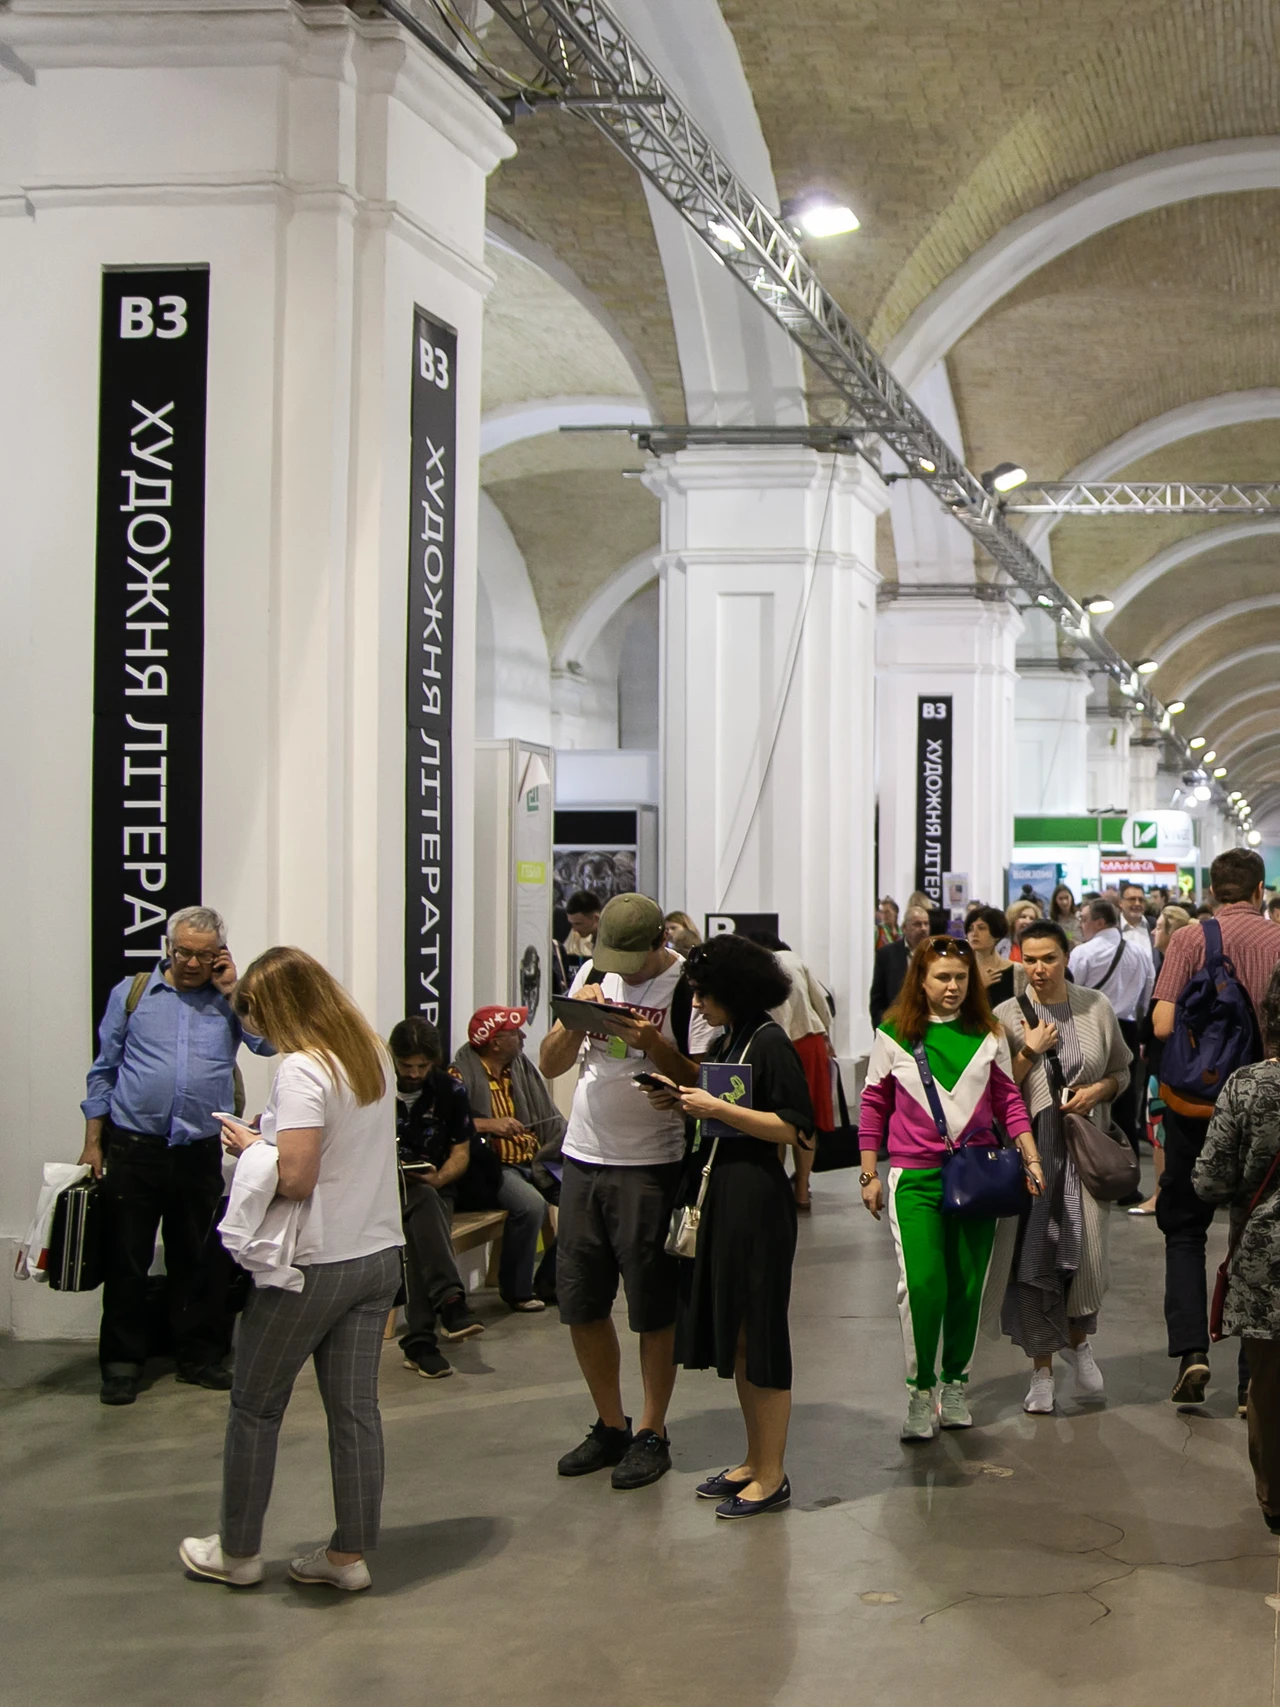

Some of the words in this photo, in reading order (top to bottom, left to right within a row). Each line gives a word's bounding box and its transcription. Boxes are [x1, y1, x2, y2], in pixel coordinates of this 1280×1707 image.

[119, 295, 188, 339] B3
[418, 336, 450, 390] B3
[119, 399, 175, 696] ХУДОЖНЯ
[420, 436, 446, 716] ХУДОЖНЯ
[922, 702, 947, 719] B3
[923, 738, 943, 837] ХУДОЖНЯ
